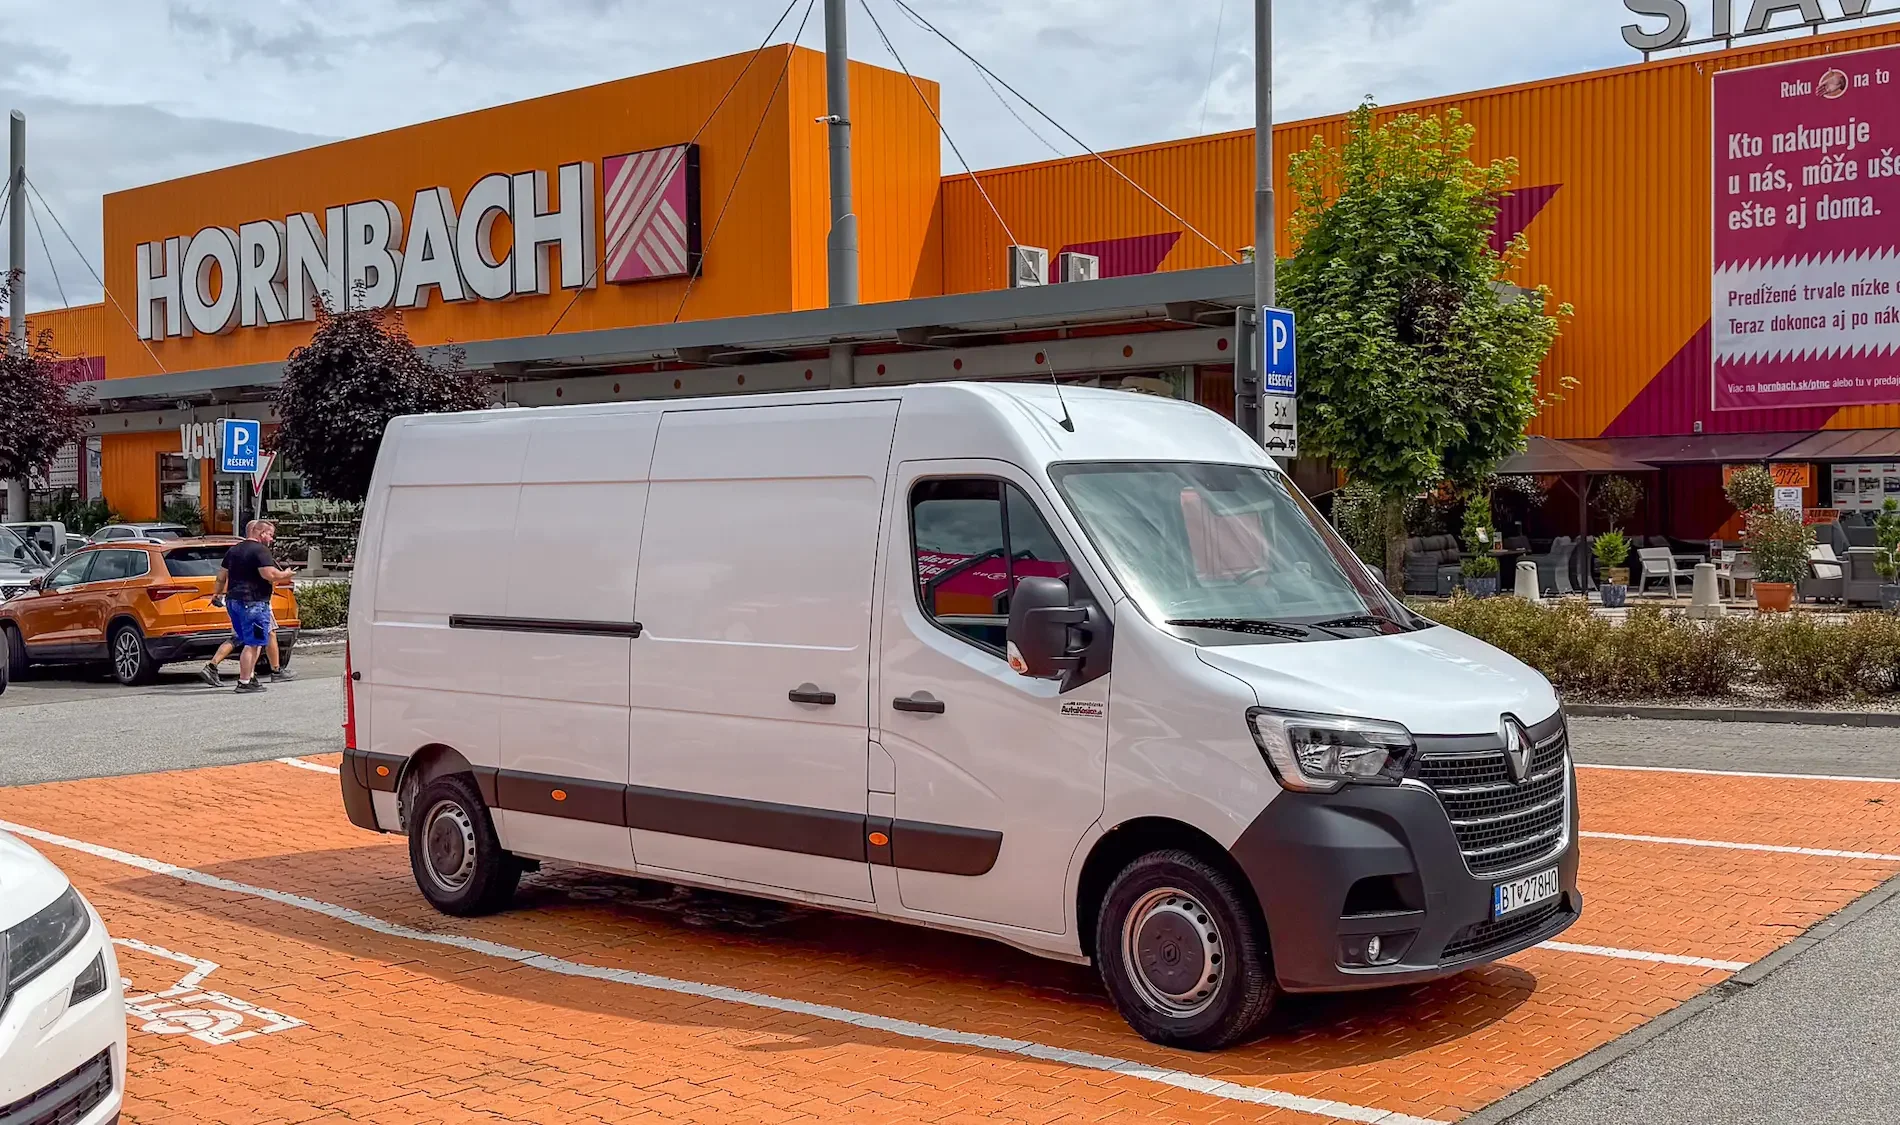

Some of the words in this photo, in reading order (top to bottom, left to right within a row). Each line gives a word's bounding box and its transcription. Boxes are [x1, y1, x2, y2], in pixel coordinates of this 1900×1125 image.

[1780, 80, 1811, 98] Ruku
[1853, 72, 1869, 87] na
[1876, 69, 1890, 84] to
[1728, 133, 1762, 160] Kto
[1772, 117, 1870, 153] nakupuje
[1728, 175, 1740, 195] u
[1749, 163, 1793, 192] nás,
[1802, 153, 1858, 186] môže
[1728, 200, 1776, 230] ešte
[1785, 197, 1807, 230] aj
[1816, 194, 1882, 221] doma.
[136, 161, 596, 341] HORNBACH
[1728, 283, 1797, 307] Predĺžené
[1803, 281, 1845, 301] trvale
[1851, 278, 1890, 297] nízke
[1729, 318, 1764, 335] Teraz
[1771, 314, 1826, 331] dokonca
[1832, 310, 1845, 331] aj
[1851, 313, 1868, 330] po
[1272, 319, 1287, 365] P
[1268, 371, 1293, 387] RÉSERVÉ
[1728, 384, 1743, 393] Viac
[1745, 384, 1756, 392] na
[1832, 377, 1853, 388] alebo
[1855, 377, 1864, 387] tu
[1274, 402, 1279, 416] 5
[233, 427, 250, 455] P
[227, 456, 255, 467] RÉSERVÉ
